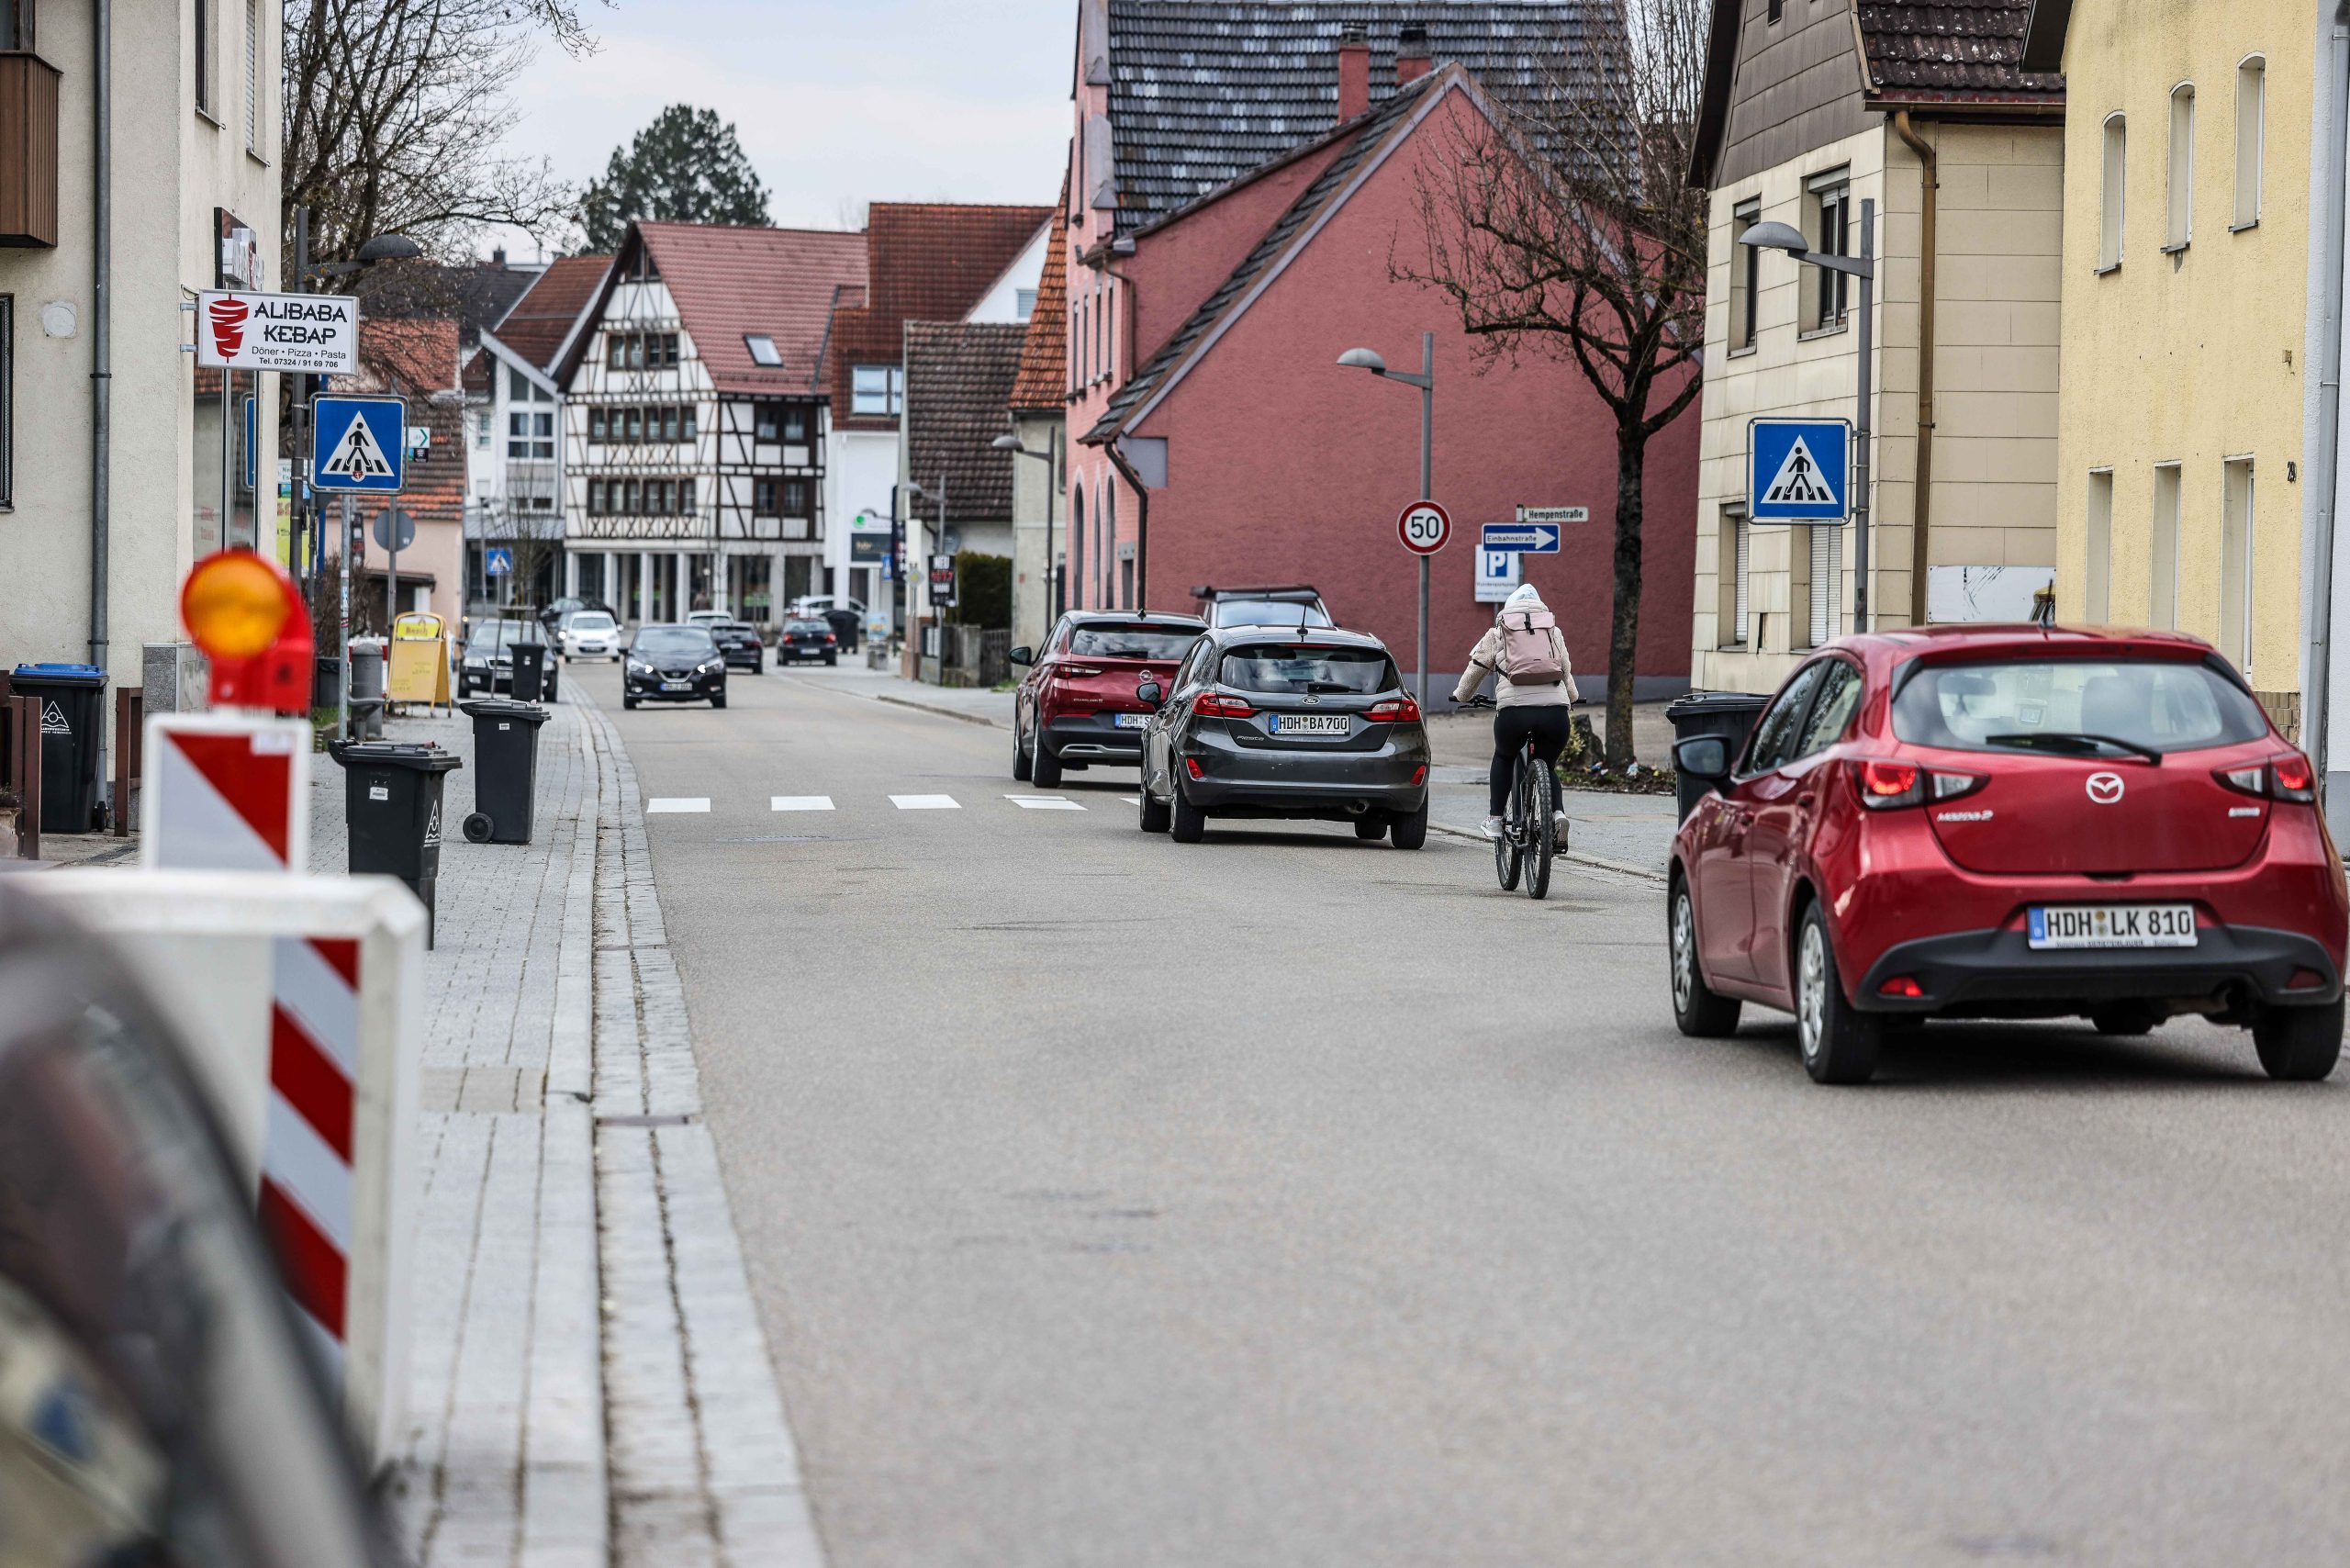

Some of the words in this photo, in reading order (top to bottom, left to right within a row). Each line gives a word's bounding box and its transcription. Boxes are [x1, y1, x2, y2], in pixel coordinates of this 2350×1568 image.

[253, 301, 348, 323] ALIBABA
[263, 324, 337, 345] KEBAP
[252, 346, 279, 356] Döner
[287, 348, 312, 358] Pizza
[320, 350, 346, 360] Pasta
[259, 357, 273, 365] Tel.
[274, 358, 297, 366] 07324
[302, 359, 311, 367] 91
[313, 360, 323, 368] 69
[324, 360, 339, 368] 706
[1528, 510, 1583, 522] Hempenstraße
[1410, 515, 1439, 539] 50
[1486, 534, 1538, 543] Einbahnstraße
[1488, 553, 1506, 577] P
[1121, 716, 1138, 725] HDH
[1279, 717, 1301, 730] HDH
[1309, 717, 1324, 730] BA
[1326, 717, 1348, 730] 700
[2046, 912, 2092, 937] HDH
[2112, 911, 2140, 936] LK
[2147, 910, 2191, 935] 810
